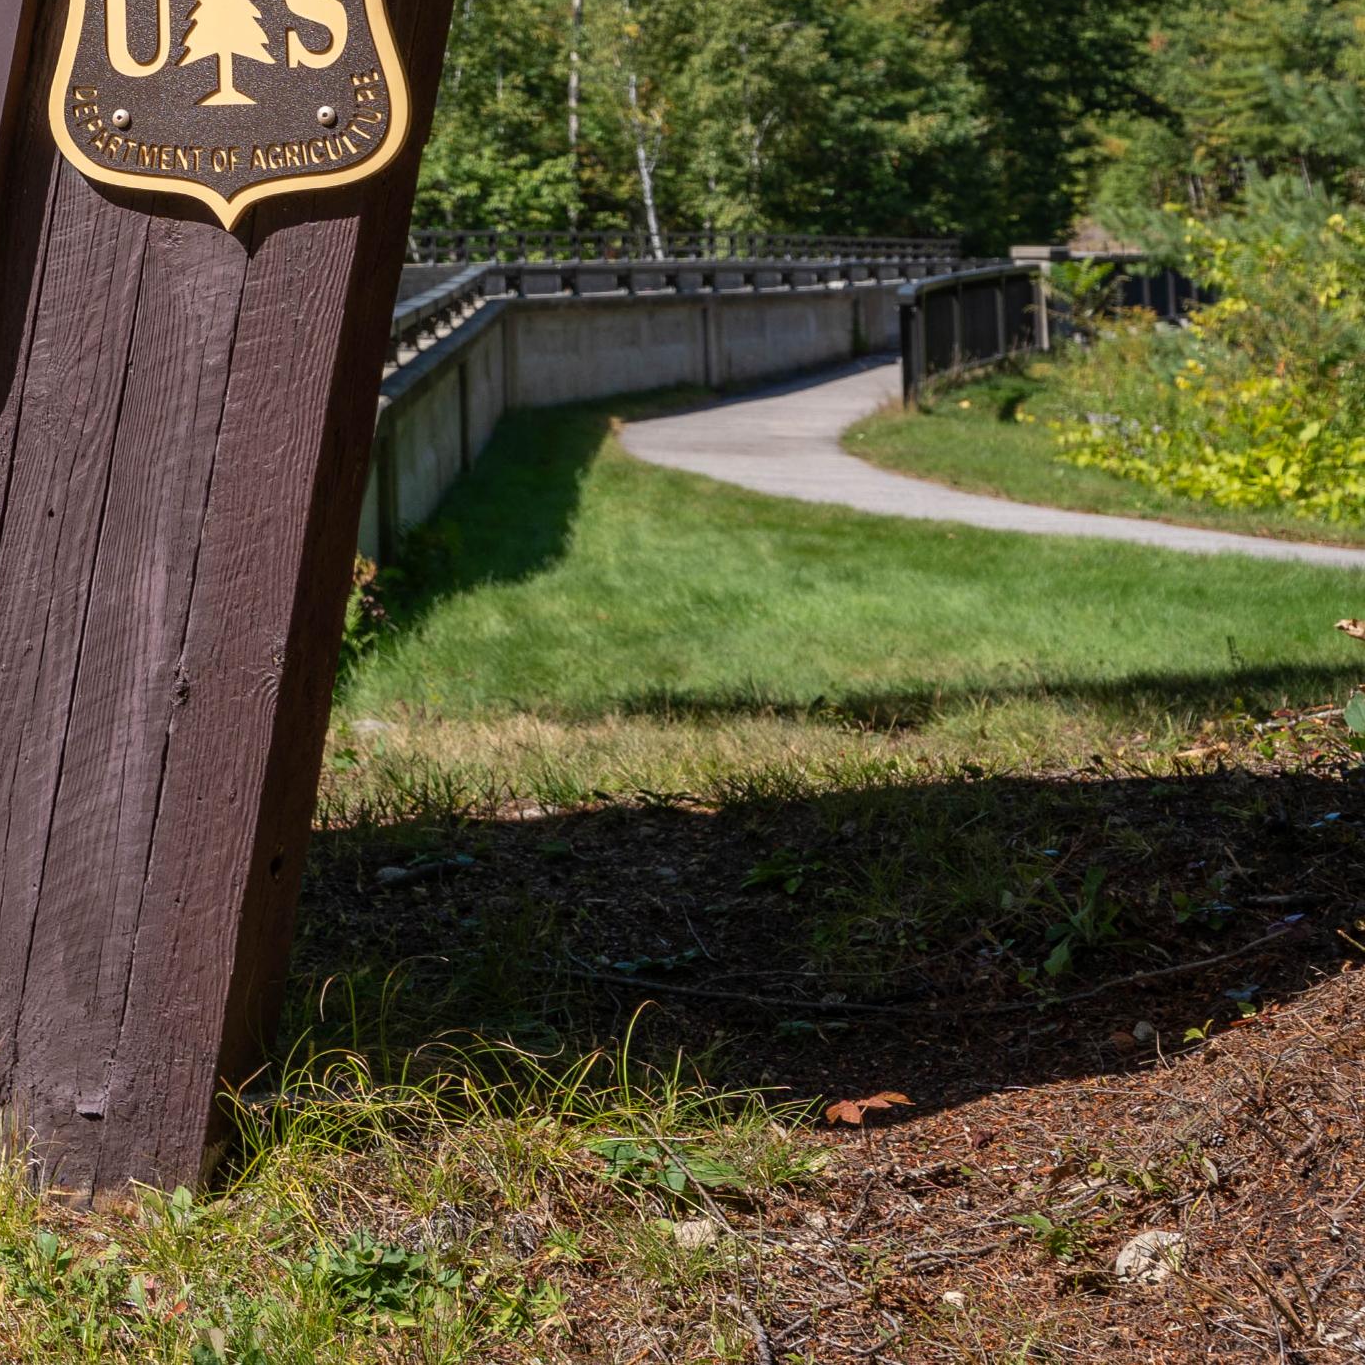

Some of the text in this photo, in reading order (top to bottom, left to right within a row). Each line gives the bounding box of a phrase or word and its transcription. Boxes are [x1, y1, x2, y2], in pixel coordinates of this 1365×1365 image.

[72, 70, 382, 172] DEPARTMENT OF AGRICULTURE
